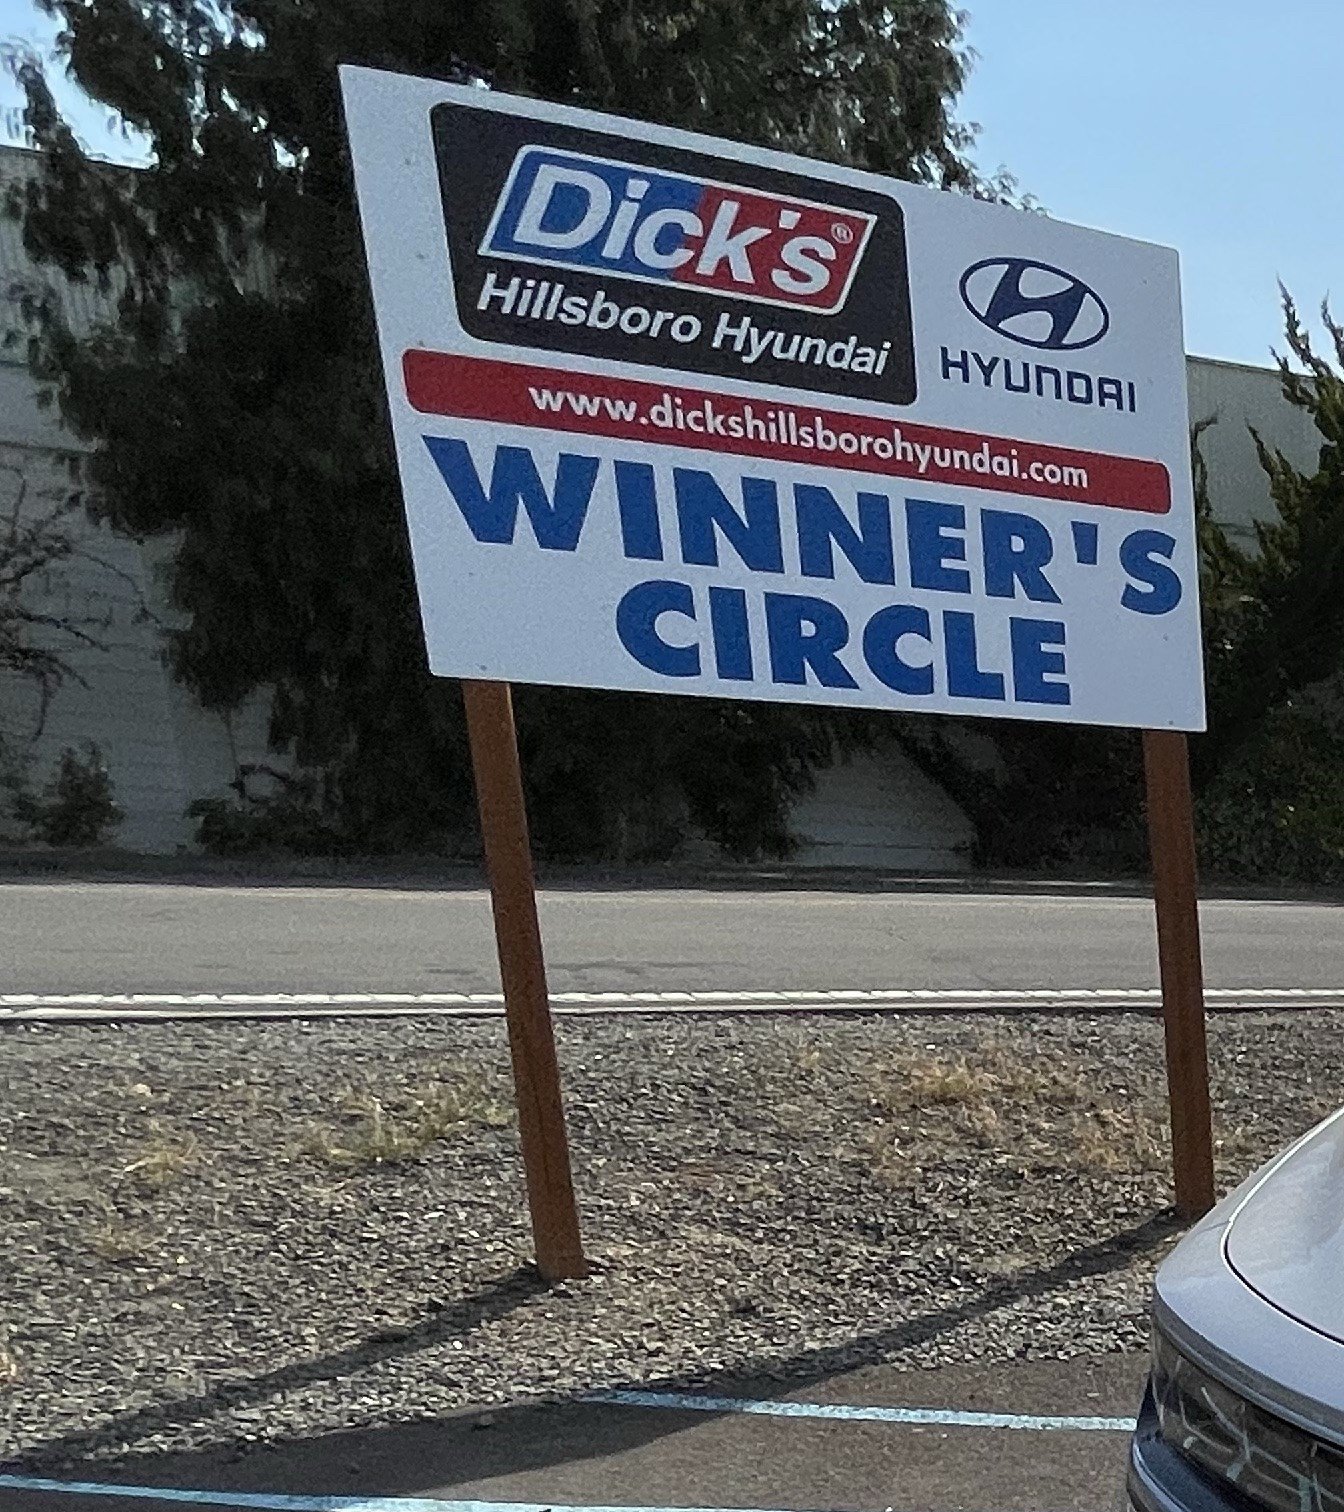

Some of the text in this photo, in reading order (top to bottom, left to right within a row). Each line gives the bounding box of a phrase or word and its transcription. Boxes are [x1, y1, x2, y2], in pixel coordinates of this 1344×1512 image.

[512, 163, 837, 296] Dick's
[477, 272, 891, 376] Hillsboro Hyundai
[941, 346, 1137, 413] HYUNDAI
[528, 383, 1088, 488] www.dickshillsborohyundai.com
[422, 434, 1183, 616] WINNER'S
[616, 579, 1072, 706] CIRCLE
